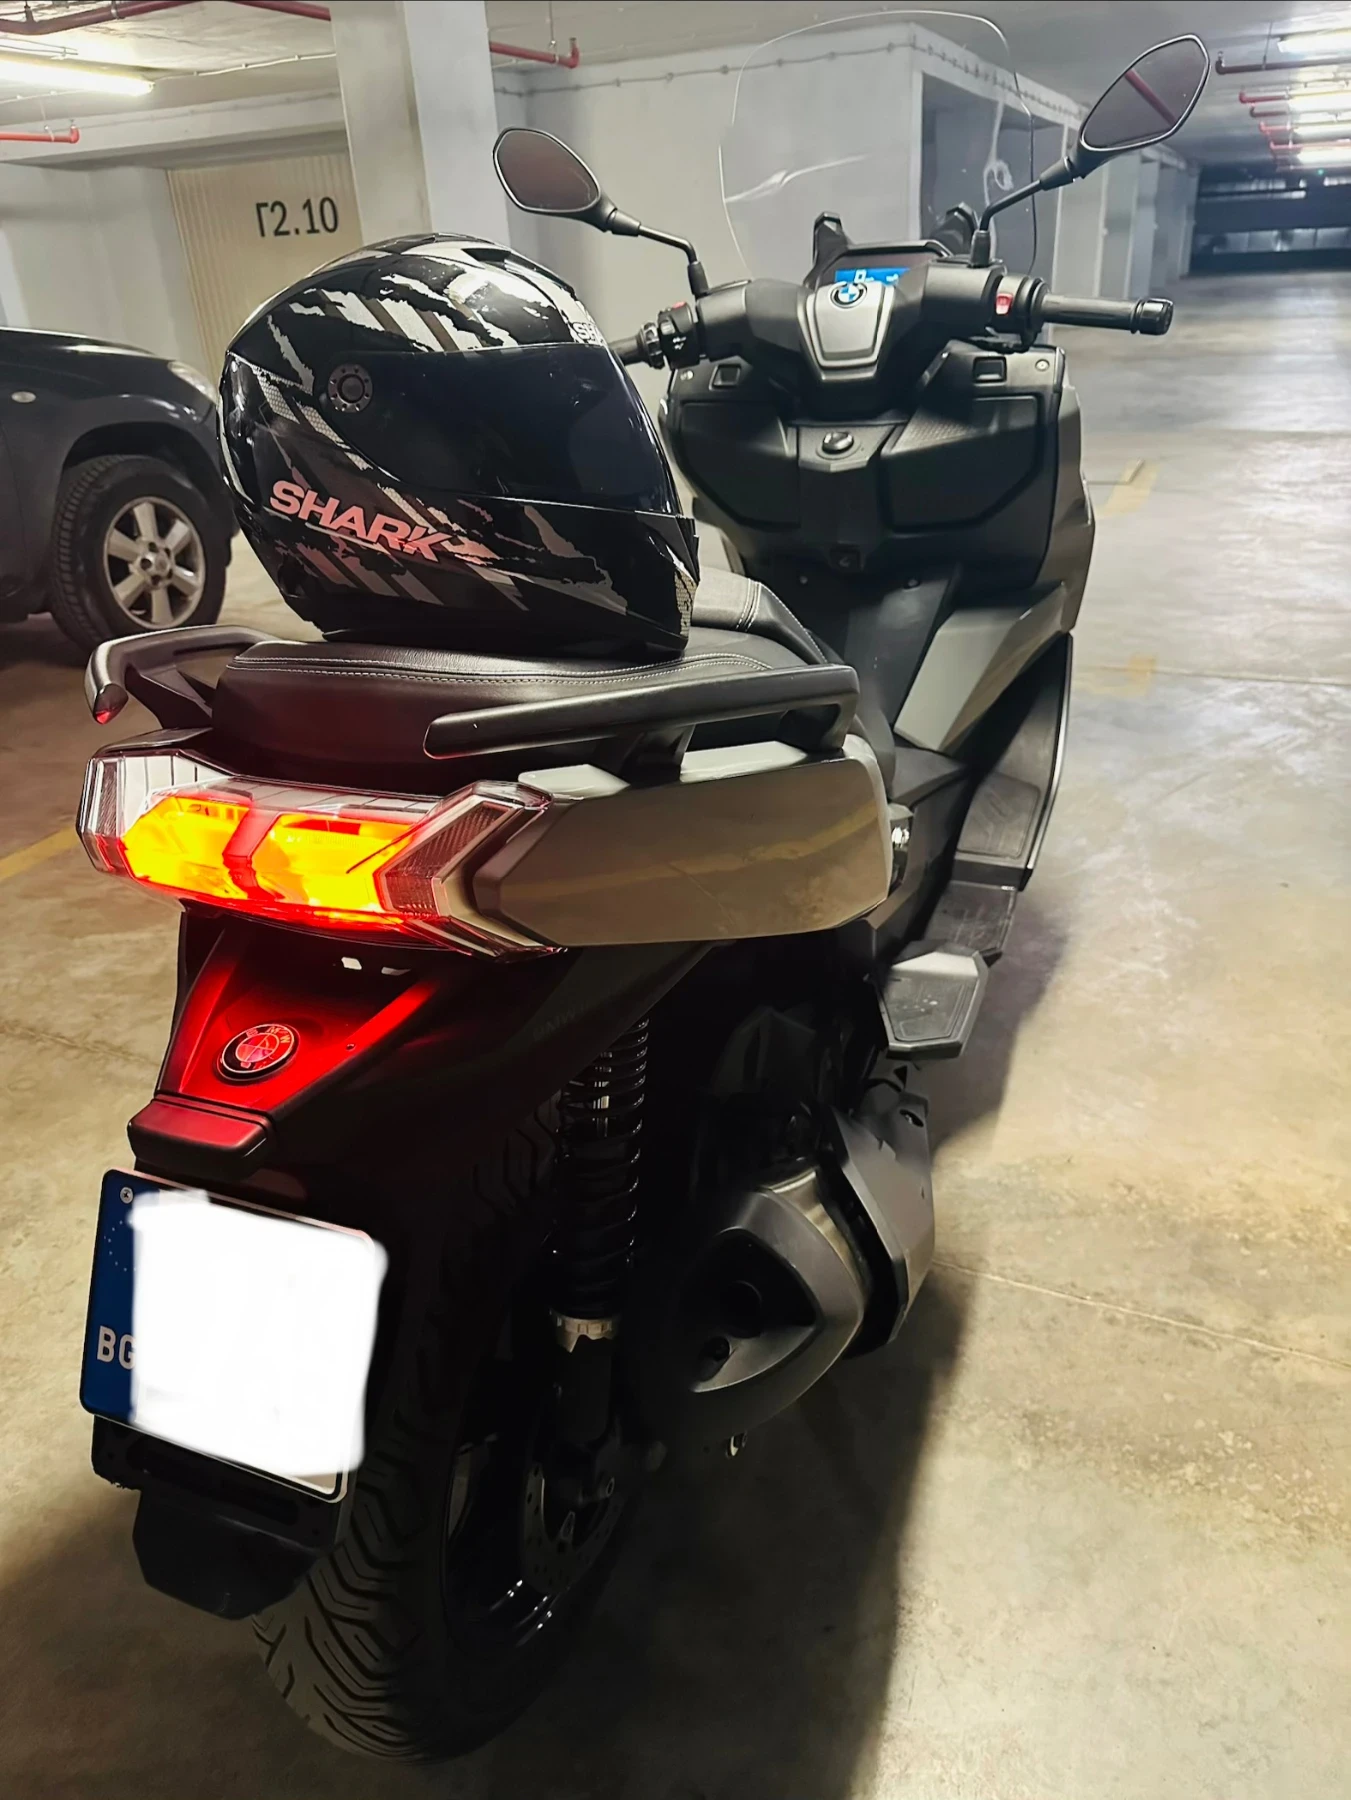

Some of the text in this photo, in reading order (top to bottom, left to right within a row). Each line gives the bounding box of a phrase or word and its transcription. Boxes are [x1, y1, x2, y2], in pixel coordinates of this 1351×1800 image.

[256, 196, 339, 237] Г2.10
[270, 480, 452, 562] SHARK
[97, 1325, 136, 1370] BG
